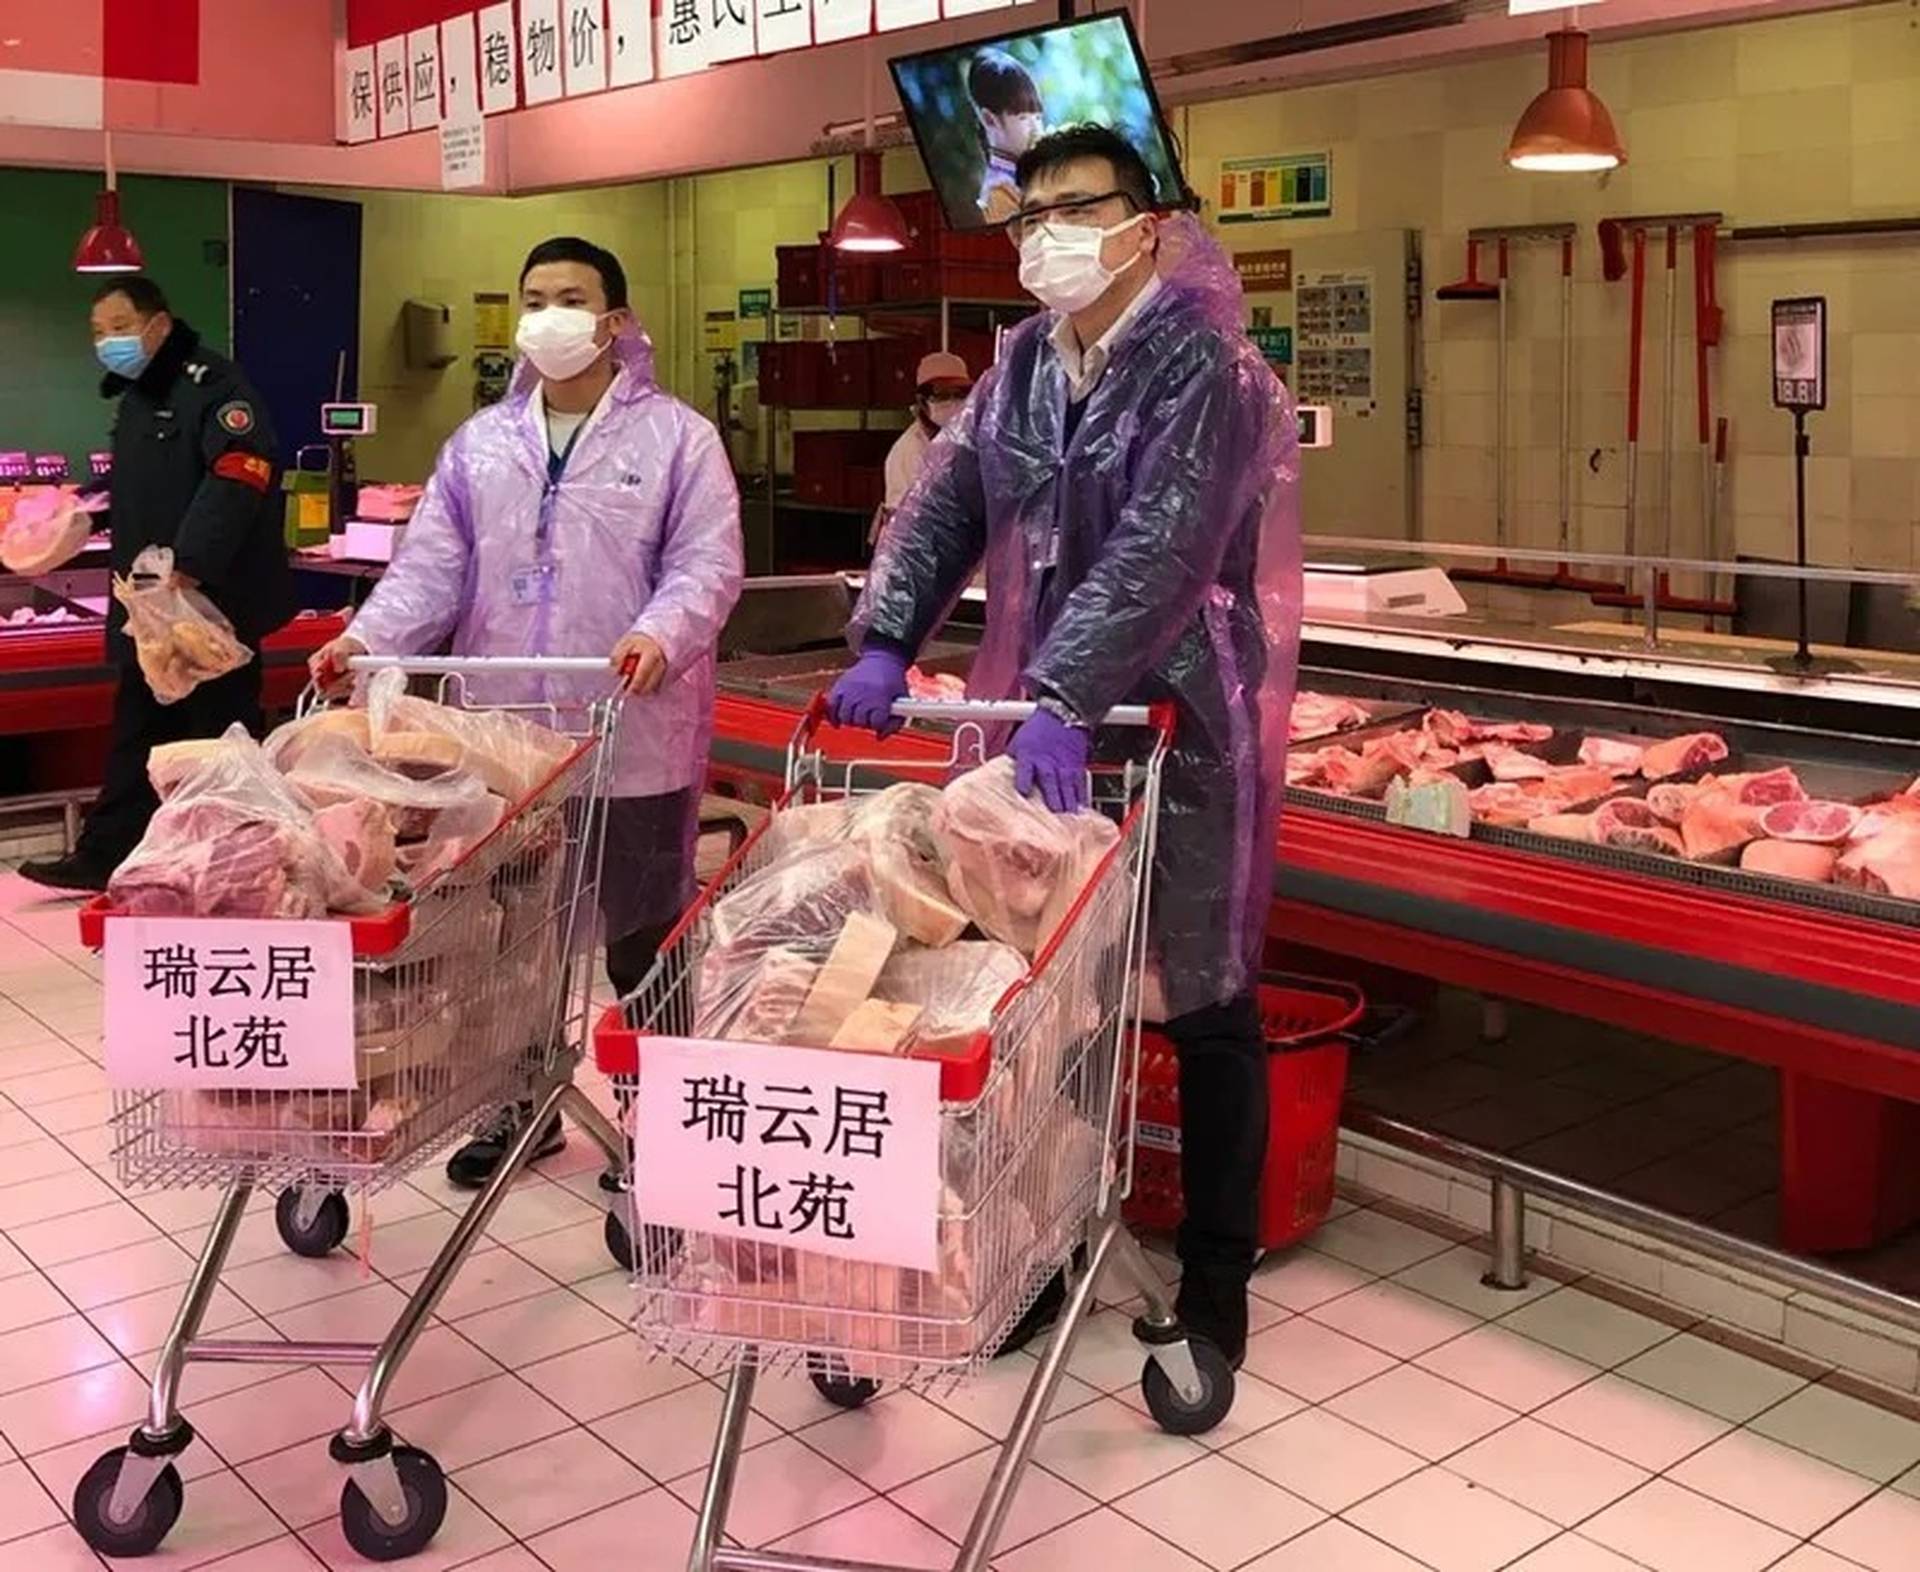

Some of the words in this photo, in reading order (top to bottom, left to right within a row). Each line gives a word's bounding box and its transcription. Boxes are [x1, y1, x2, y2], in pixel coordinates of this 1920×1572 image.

[144, 944, 316, 1000] 瑞云居
[174, 1014, 289, 1069] 北苑
[682, 1074, 893, 1158] 瑞云居
[717, 1164, 855, 1239] 北苑
